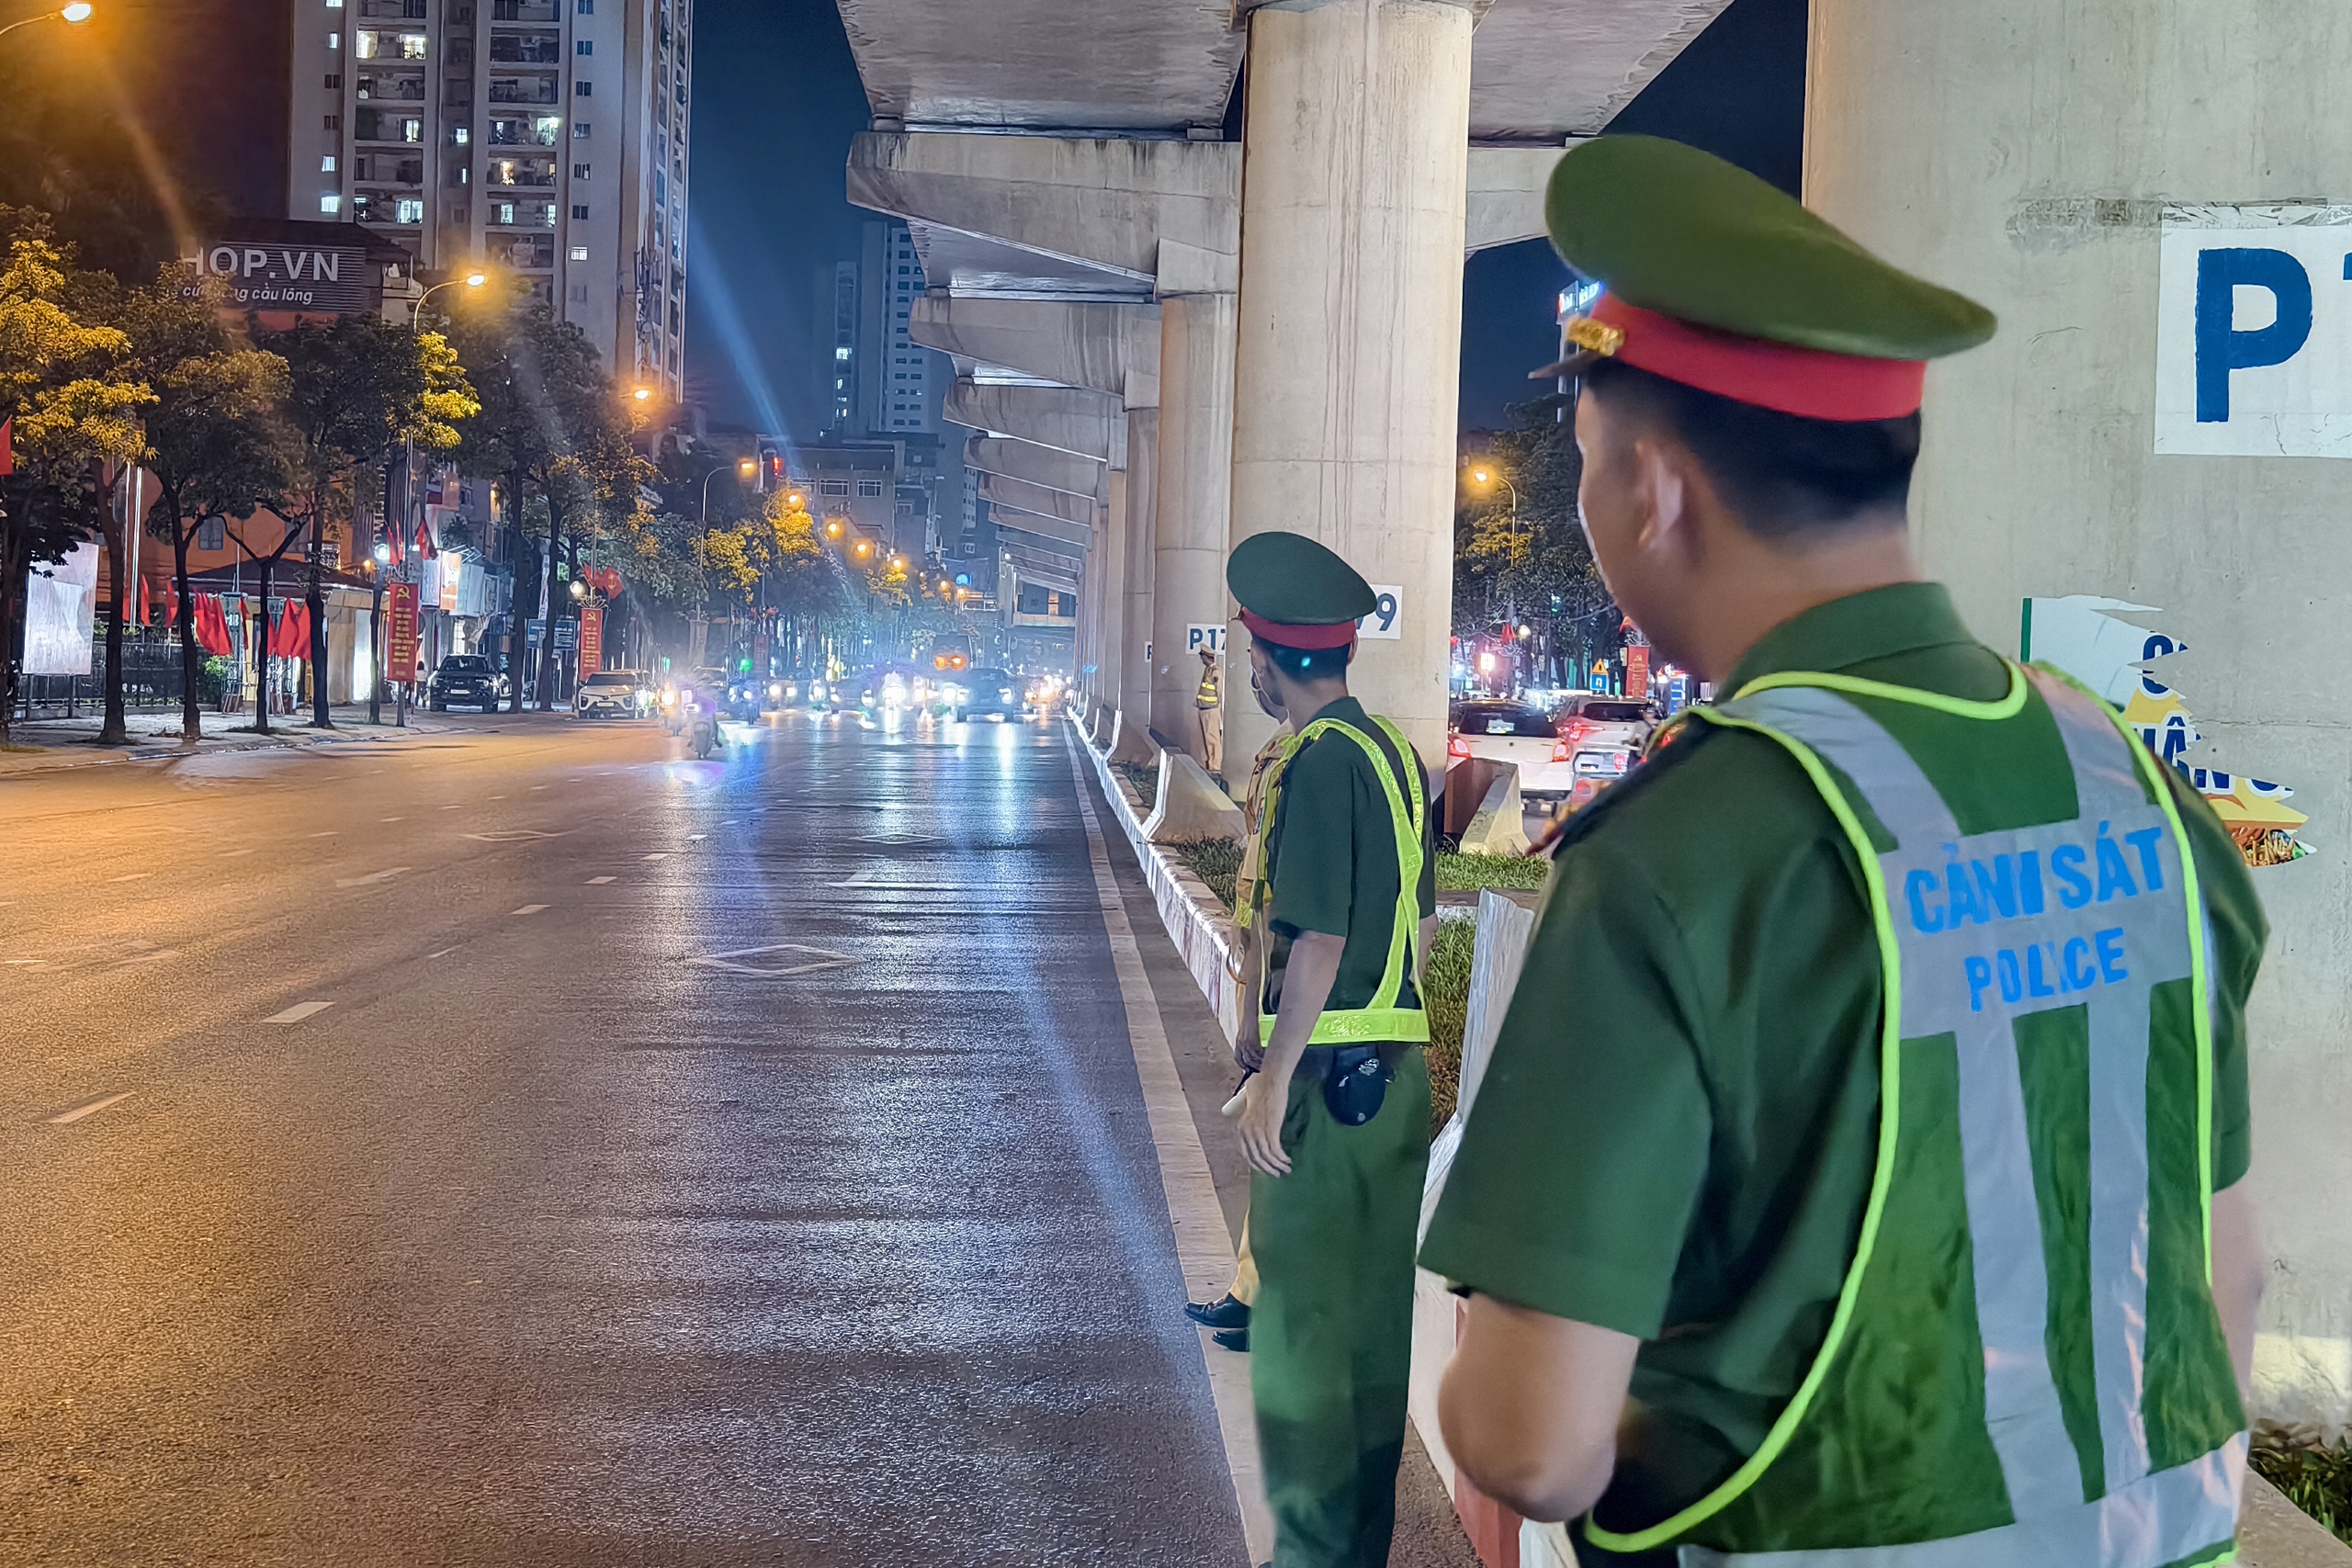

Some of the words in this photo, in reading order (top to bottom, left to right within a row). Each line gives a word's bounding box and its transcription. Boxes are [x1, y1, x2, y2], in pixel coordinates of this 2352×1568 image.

[252, 282, 278, 300] cầu
[282, 288, 313, 305] lông
[2051, 819, 2164, 910] SÁT
[1963, 927, 2130, 1013] POLICE
